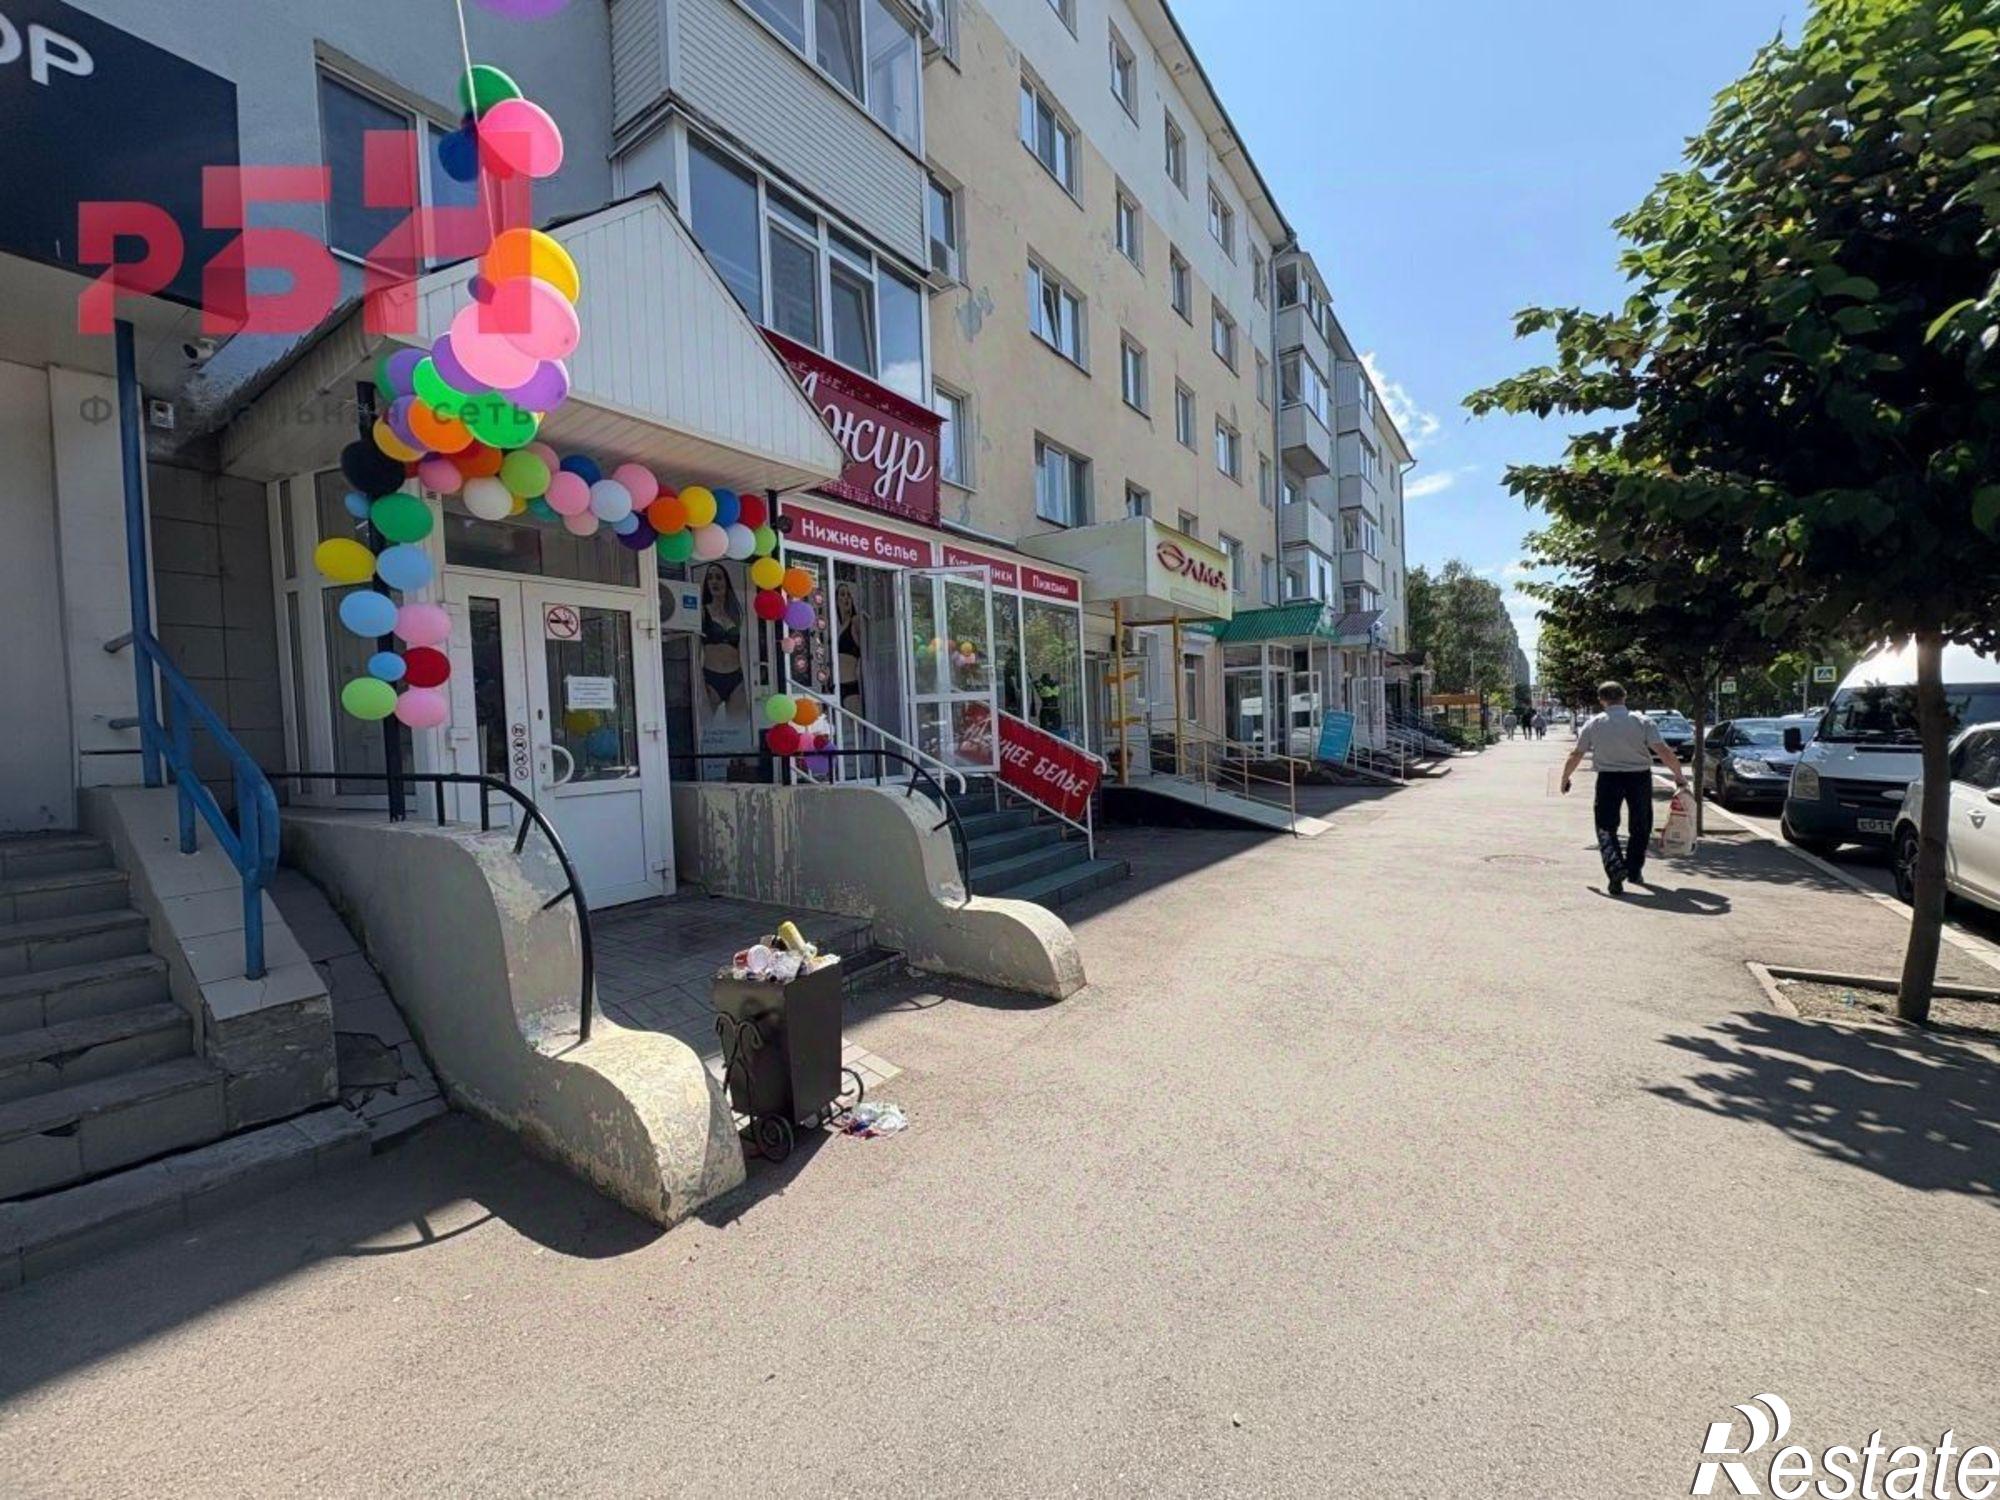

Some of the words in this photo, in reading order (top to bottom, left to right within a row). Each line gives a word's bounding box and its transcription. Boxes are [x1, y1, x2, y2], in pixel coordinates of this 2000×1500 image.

[801, 518, 870, 551] Нижнее
[874, 536, 918, 561] белье
[1032, 757, 1089, 797] БЕЛЬЕ
